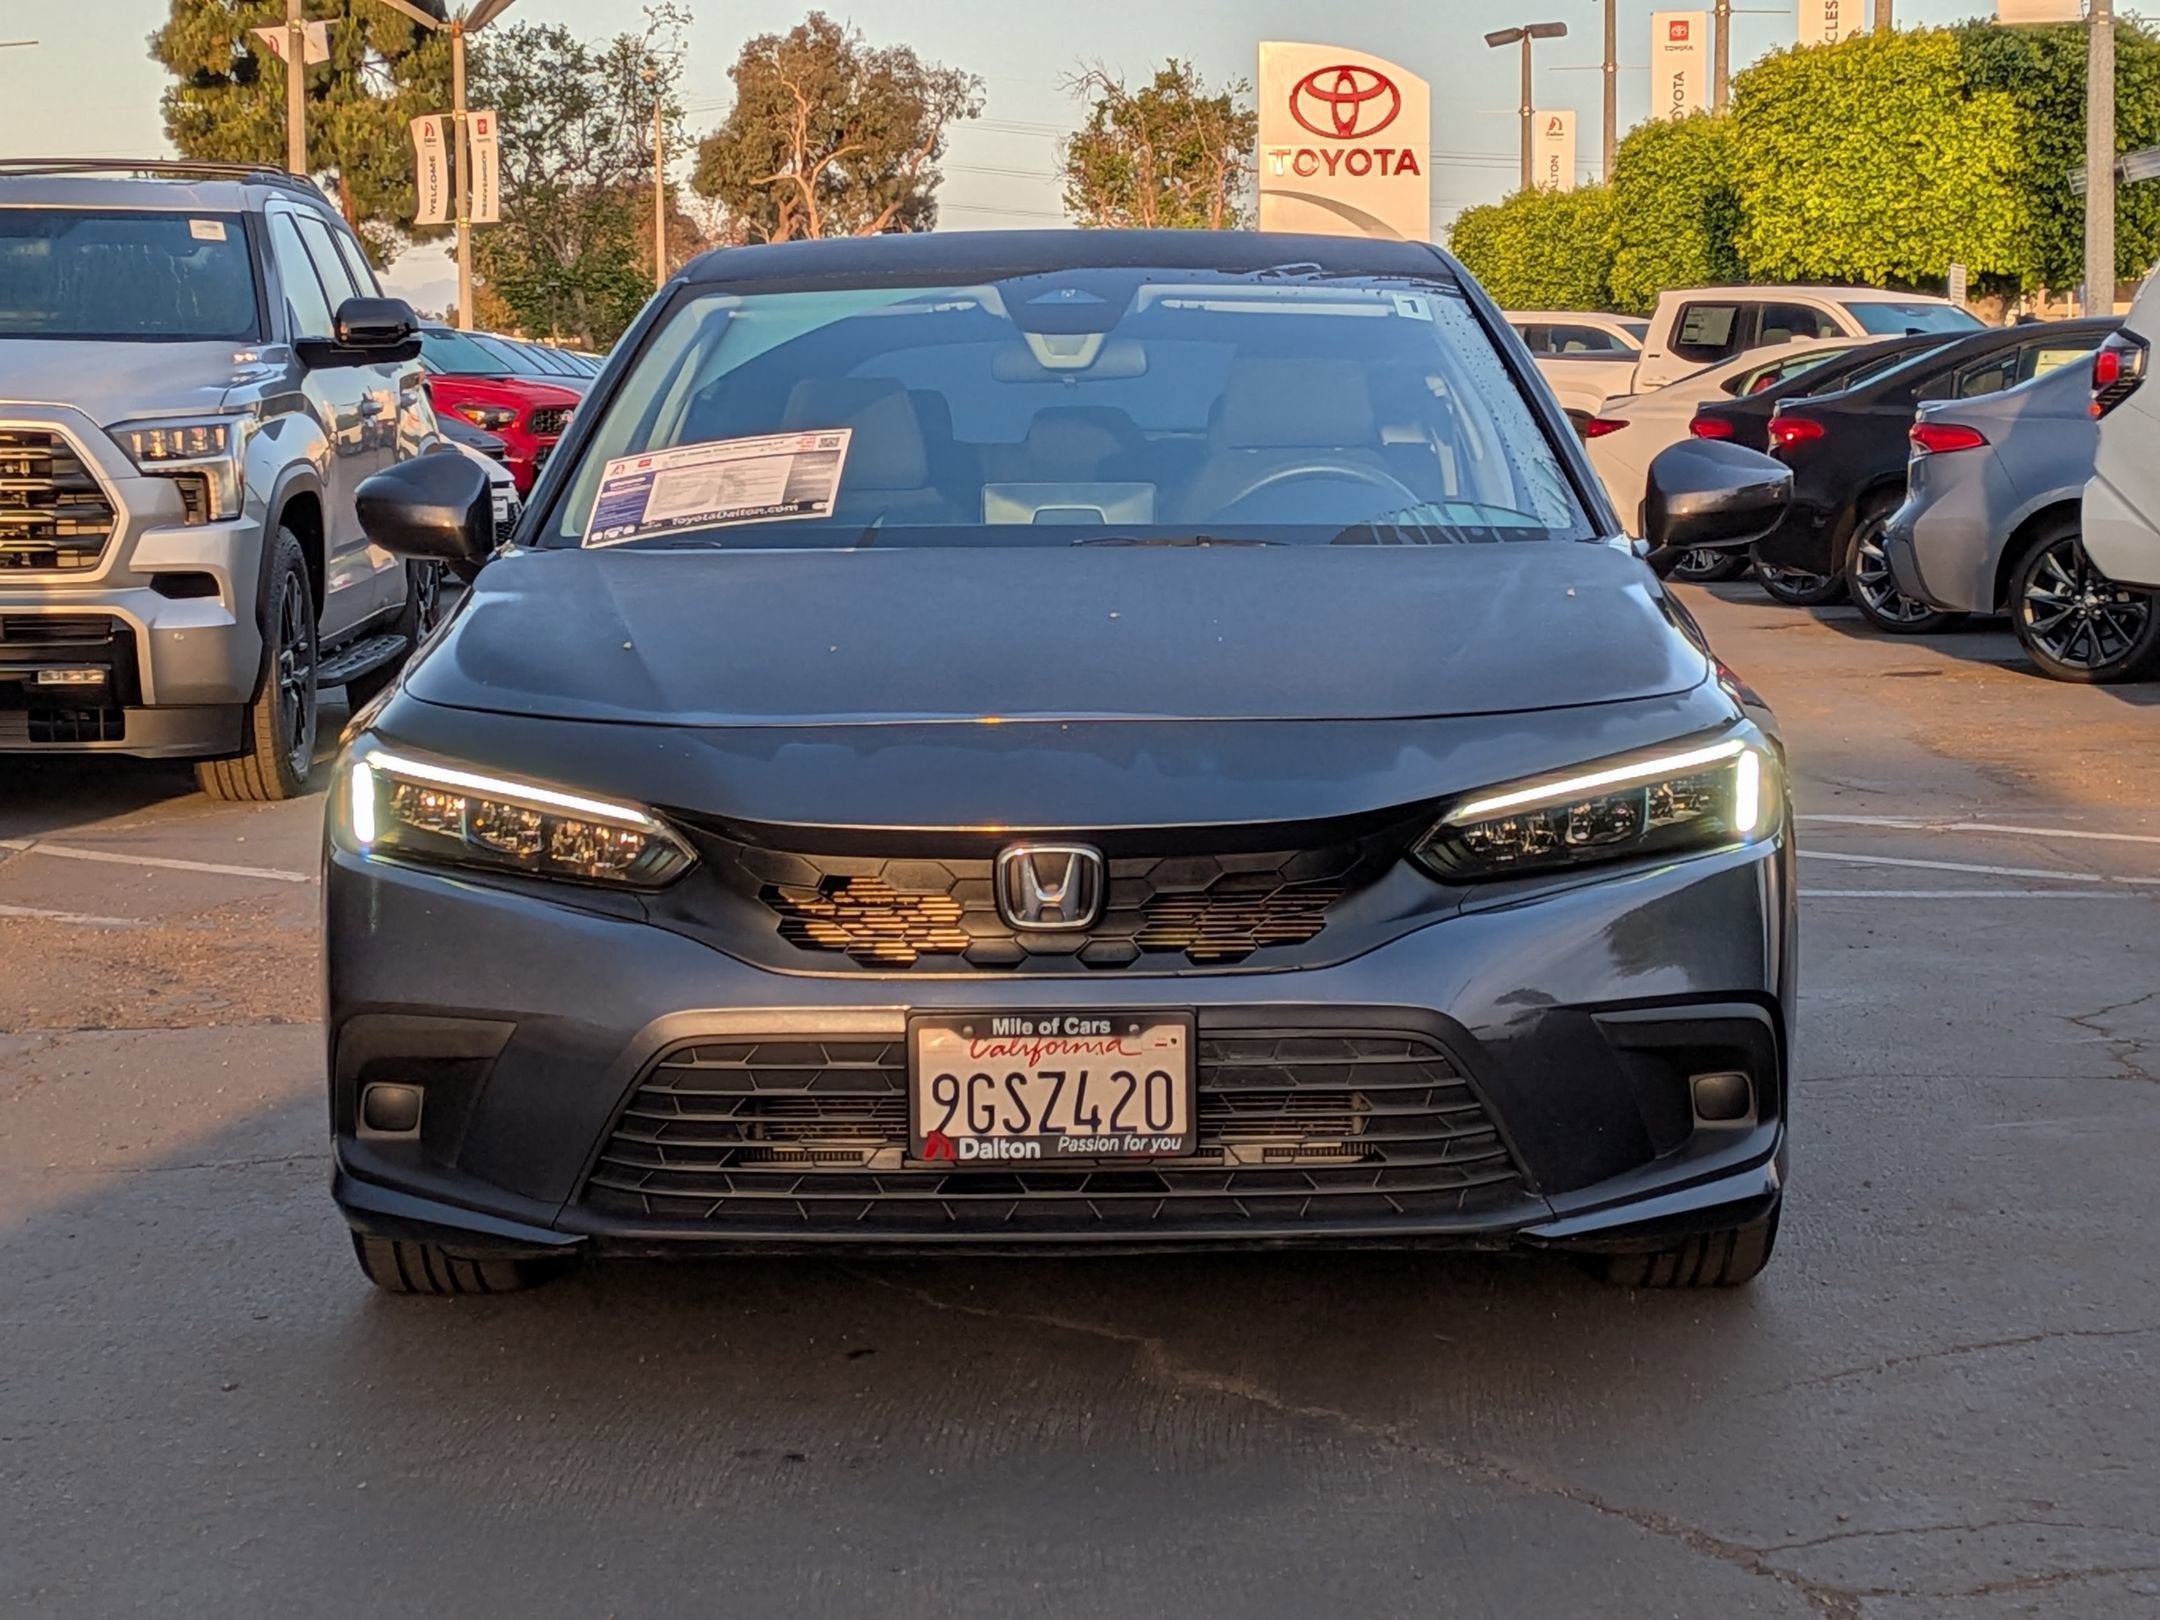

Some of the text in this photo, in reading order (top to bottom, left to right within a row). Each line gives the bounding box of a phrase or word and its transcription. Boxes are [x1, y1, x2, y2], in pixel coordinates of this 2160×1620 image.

[1268, 148, 1421, 177] TOYOTA
[428, 155, 438, 216] WELCOME
[671, 503, 799, 526] ToyotaDalton.com
[992, 1017, 1112, 1036] Mile of Cars
[969, 1036, 1142, 1068] California
[931, 1070, 1174, 1134] 9GSZ420
[959, 1134, 1183, 1160] Dalton Passion for you
